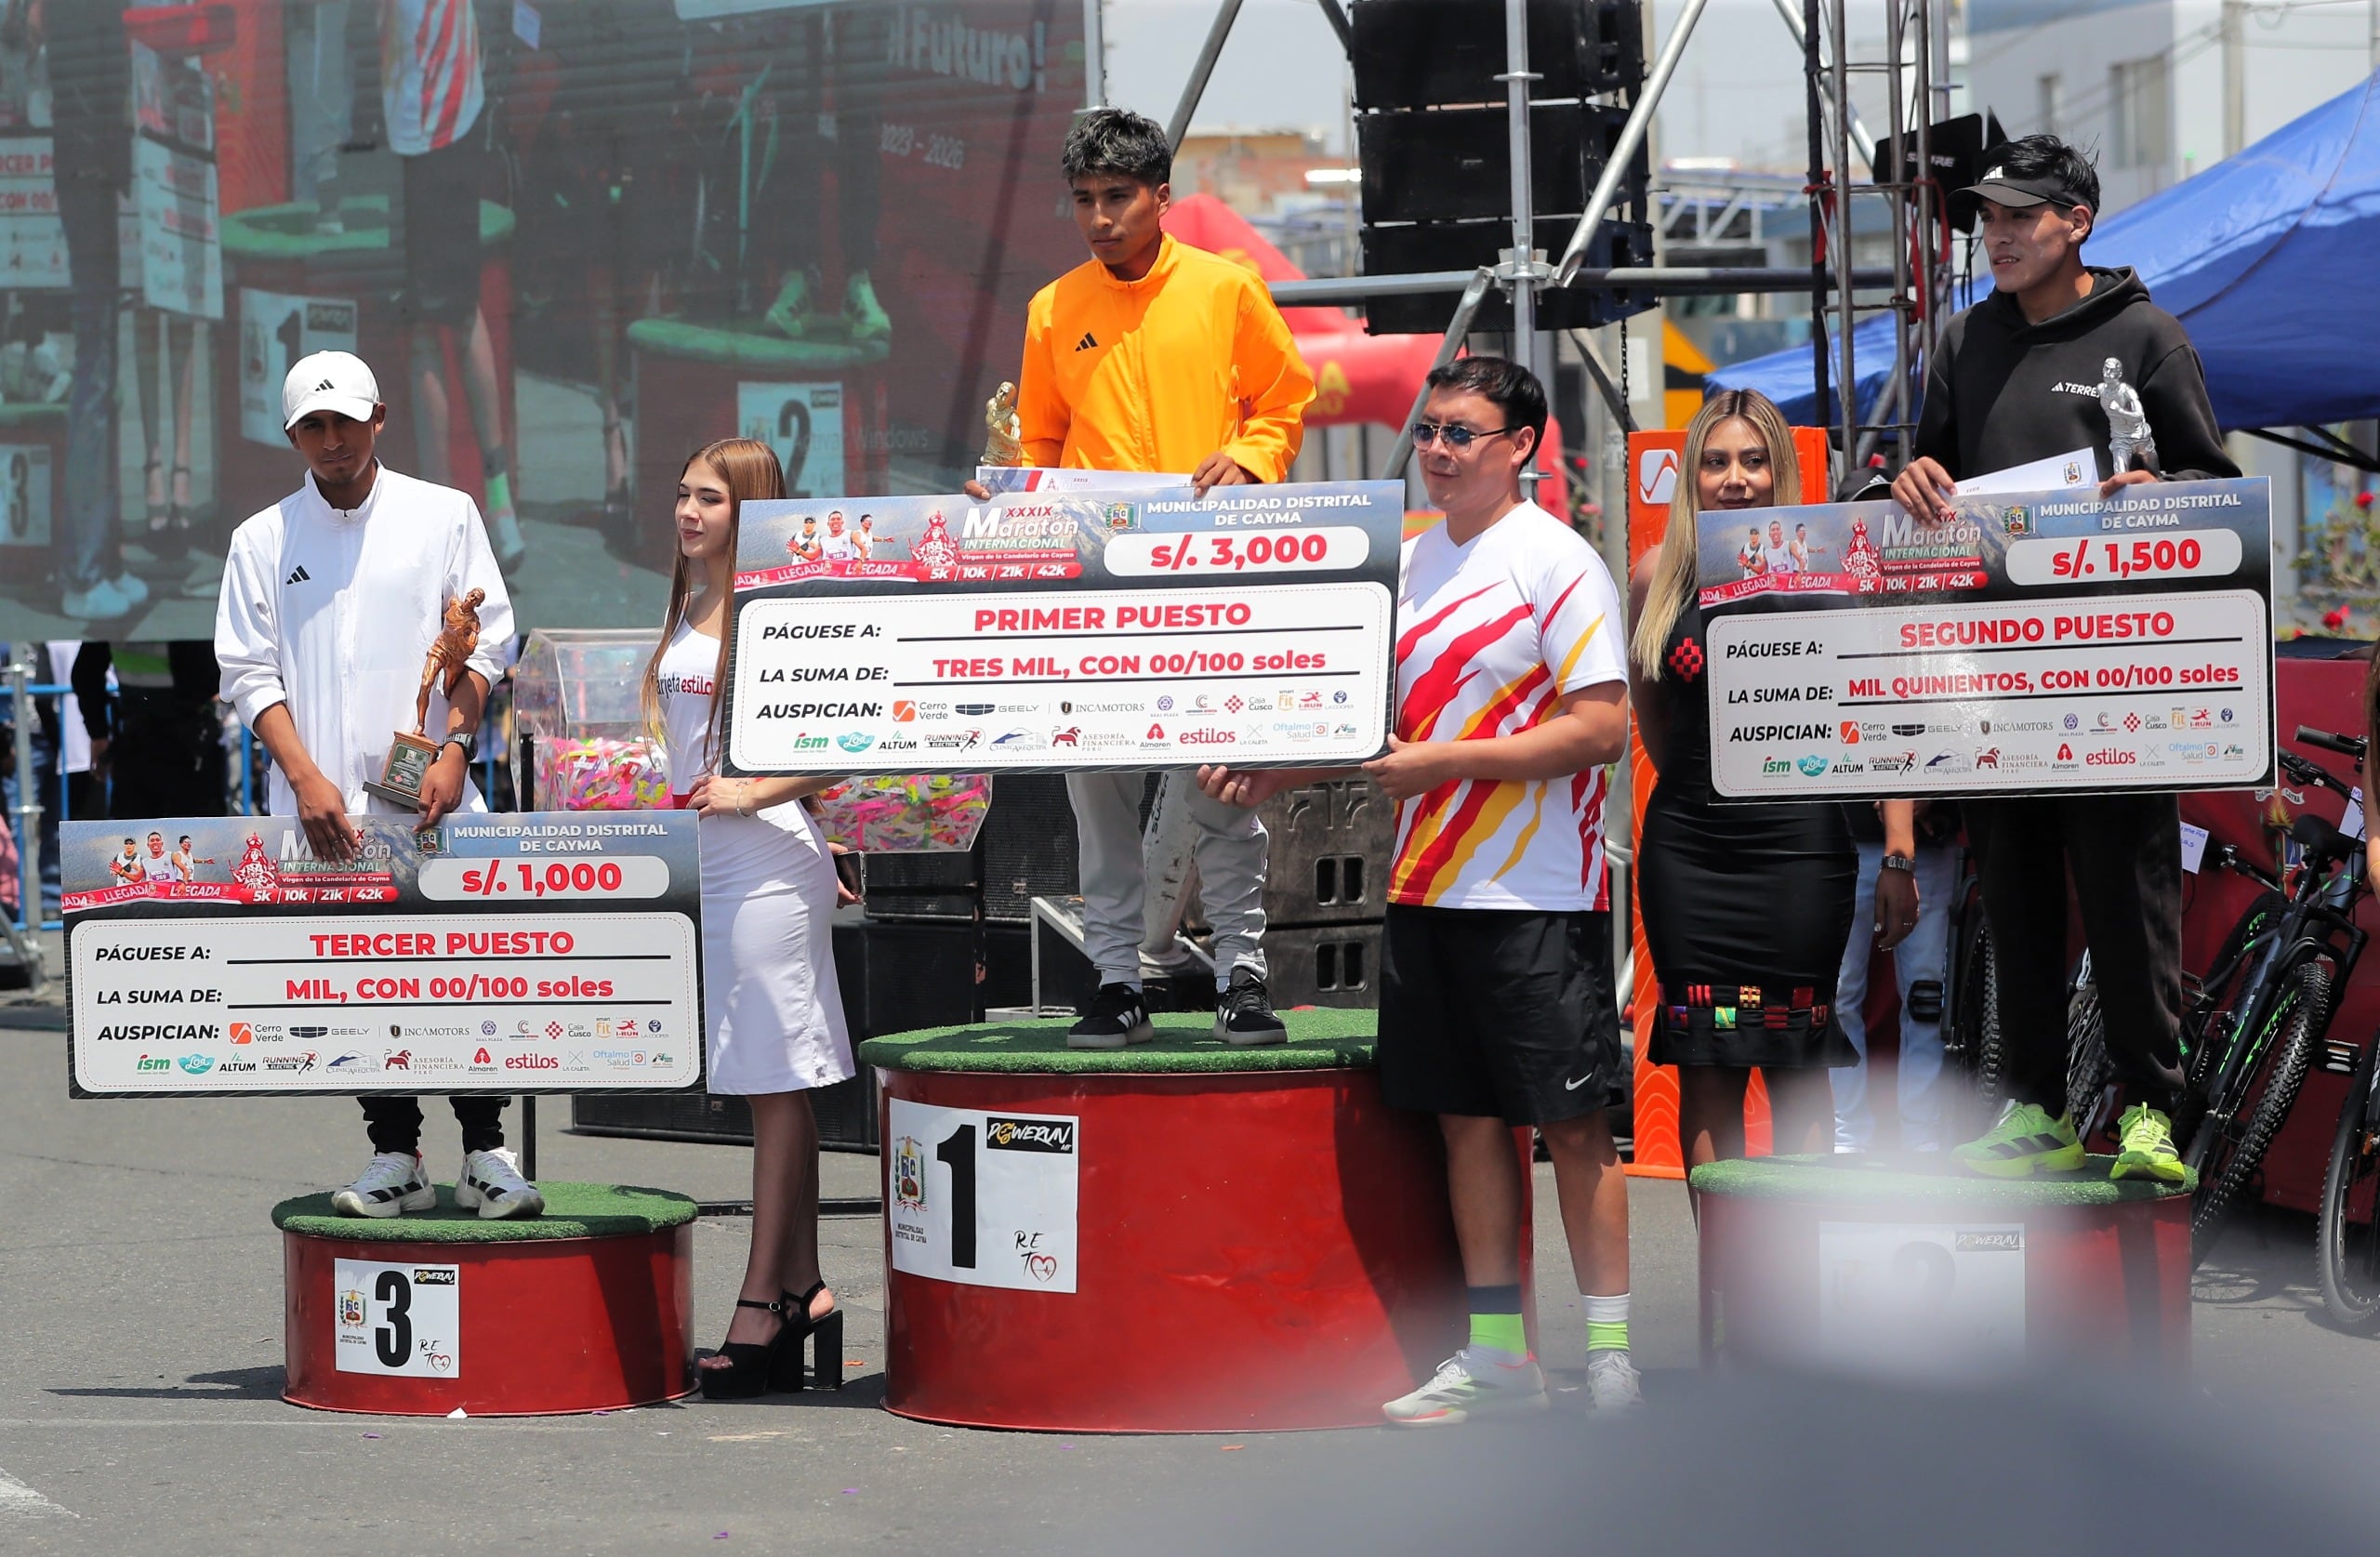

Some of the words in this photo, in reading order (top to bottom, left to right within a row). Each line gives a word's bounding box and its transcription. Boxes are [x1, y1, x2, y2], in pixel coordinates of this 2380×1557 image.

[2065, 382, 2100, 398] TERRE
[778, 399, 812, 497] 2
[9, 453, 29, 537] 3
[1005, 506, 1053, 518] XXXIX
[1147, 497, 1281, 514] MUNICIPALIDAD
[1283, 494, 1372, 509] DISTRITAL
[2041, 499, 2161, 518] MUNICIPALIDAD
[2164, 494, 2241, 510] DISTRITAL
[961, 507, 1079, 539] Maratón
[1215, 513, 1237, 526] DE
[1241, 511, 1302, 525] CAYMA
[2101, 517, 2122, 530] DE
[2126, 514, 2179, 528] CAYMA
[1882, 514, 1981, 548] Maratón
[964, 538, 1065, 550] INTERNACIONAL
[1210, 534, 1328, 570] 3,000
[1885, 547, 1972, 559] INTERNACIONAL
[2105, 538, 2202, 578] 1,500
[930, 567, 949, 580] 5k
[962, 567, 987, 578] 10k
[999, 566, 1025, 578] 21k
[1037, 564, 1067, 577] 42k
[1858, 579, 1875, 592] 5k
[1885, 578, 1907, 590] 10k
[1918, 576, 1938, 588] 21k
[1950, 574, 1975, 587] 42k
[974, 607, 1105, 632] PRIMER
[1116, 602, 1251, 628] PUESTO
[762, 622, 856, 640] PÁGUESE
[860, 624, 882, 640] A:
[1900, 618, 2044, 648] SEGUNDO
[2054, 612, 2174, 640] PUESTO
[1726, 640, 1801, 658] PÁGUESE
[1805, 641, 1823, 654] A:
[932, 657, 1003, 679] TRES
[1012, 656, 1071, 680] MIL,
[1078, 654, 1141, 676] CON
[1149, 651, 1244, 675] 00/100
[1252, 649, 1327, 670] soles
[760, 668, 786, 683] LA
[790, 667, 850, 682] SUMA
[854, 666, 889, 681] DE:
[1848, 680, 1886, 697] MIL
[1892, 672, 2034, 699] QUINIENTOS,
[2041, 670, 2089, 690] CON
[2096, 665, 2173, 688] 00/100
[2180, 664, 2239, 683] soles
[656, 673, 680, 699] arjeta
[681, 674, 714, 695] estilo
[1728, 689, 1749, 704] LA
[1753, 688, 1801, 702] SUMA
[1806, 687, 1833, 700] DE:
[756, 702, 883, 719] AUSPICIAN:
[919, 702, 947, 710] Cerro
[998, 705, 1039, 713] GEELY
[1076, 703, 1145, 713] INCAMOTORS
[1249, 703, 1273, 711] Cusco
[919, 712, 948, 720] Verde
[2145, 714, 2161, 722] Caja
[1273, 722, 1311, 732] Oftalmo
[1862, 722, 1885, 731] Cerro
[1928, 724, 1962, 732] GEELY
[1993, 721, 2054, 732] INCAMOTORS
[2145, 720, 2167, 729] Cusco
[794, 732, 829, 749] ism
[924, 733, 969, 742] RUNNING
[1180, 728, 1236, 745] estilos
[1287, 731, 1311, 739] Salud
[1729, 723, 1831, 743] AUSPICIAN:
[1862, 732, 1887, 742] Verde
[879, 741, 917, 750] ALTUM
[2168, 742, 2203, 752] Oftalmo
[1869, 756, 1906, 764] RUNNING
[2086, 747, 2136, 765] estilos
[2181, 750, 2203, 760] Salud
[1763, 756, 1791, 772] ism
[1831, 763, 1863, 773] ALTUM
[454, 825, 582, 838] MUNICIPALIDAD
[586, 824, 668, 837] DISTRITAL
[520, 840, 541, 852] DE
[546, 839, 602, 851] CAYMA
[518, 863, 622, 897] 1,000
[253, 889, 271, 902] 5k
[284, 890, 309, 901] 10k
[321, 890, 344, 901] 21k
[356, 889, 384, 900] 42k
[310, 932, 436, 957] TERCER
[446, 931, 575, 955] PUESTO
[95, 944, 186, 962] PÁGUESE
[191, 946, 211, 960] A:
[97, 990, 122, 1005] LA
[126, 989, 184, 1004] SUMA
[190, 988, 223, 1003] DE:
[285, 979, 348, 1004] MIL,
[356, 978, 420, 1000] CON
[430, 973, 528, 1000] 00/100
[536, 975, 614, 997] soles
[97, 1025, 219, 1041] AUSPICIAN:
[255, 1024, 282, 1033] Cerro
[331, 1027, 370, 1036] GEELY
[404, 1027, 469, 1036] INCAMOTORS
[568, 1029, 591, 1037] Cusco
[255, 1034, 284, 1042] Verde
[137, 1054, 171, 1070] ism
[262, 1056, 306, 1064] RUNNING
[505, 1053, 559, 1069] estilos
[593, 1050, 629, 1059] Oftalmo
[218, 1062, 257, 1072] ALTUM
[937, 1124, 976, 1269] 1
[376, 1270, 412, 1367] 3
